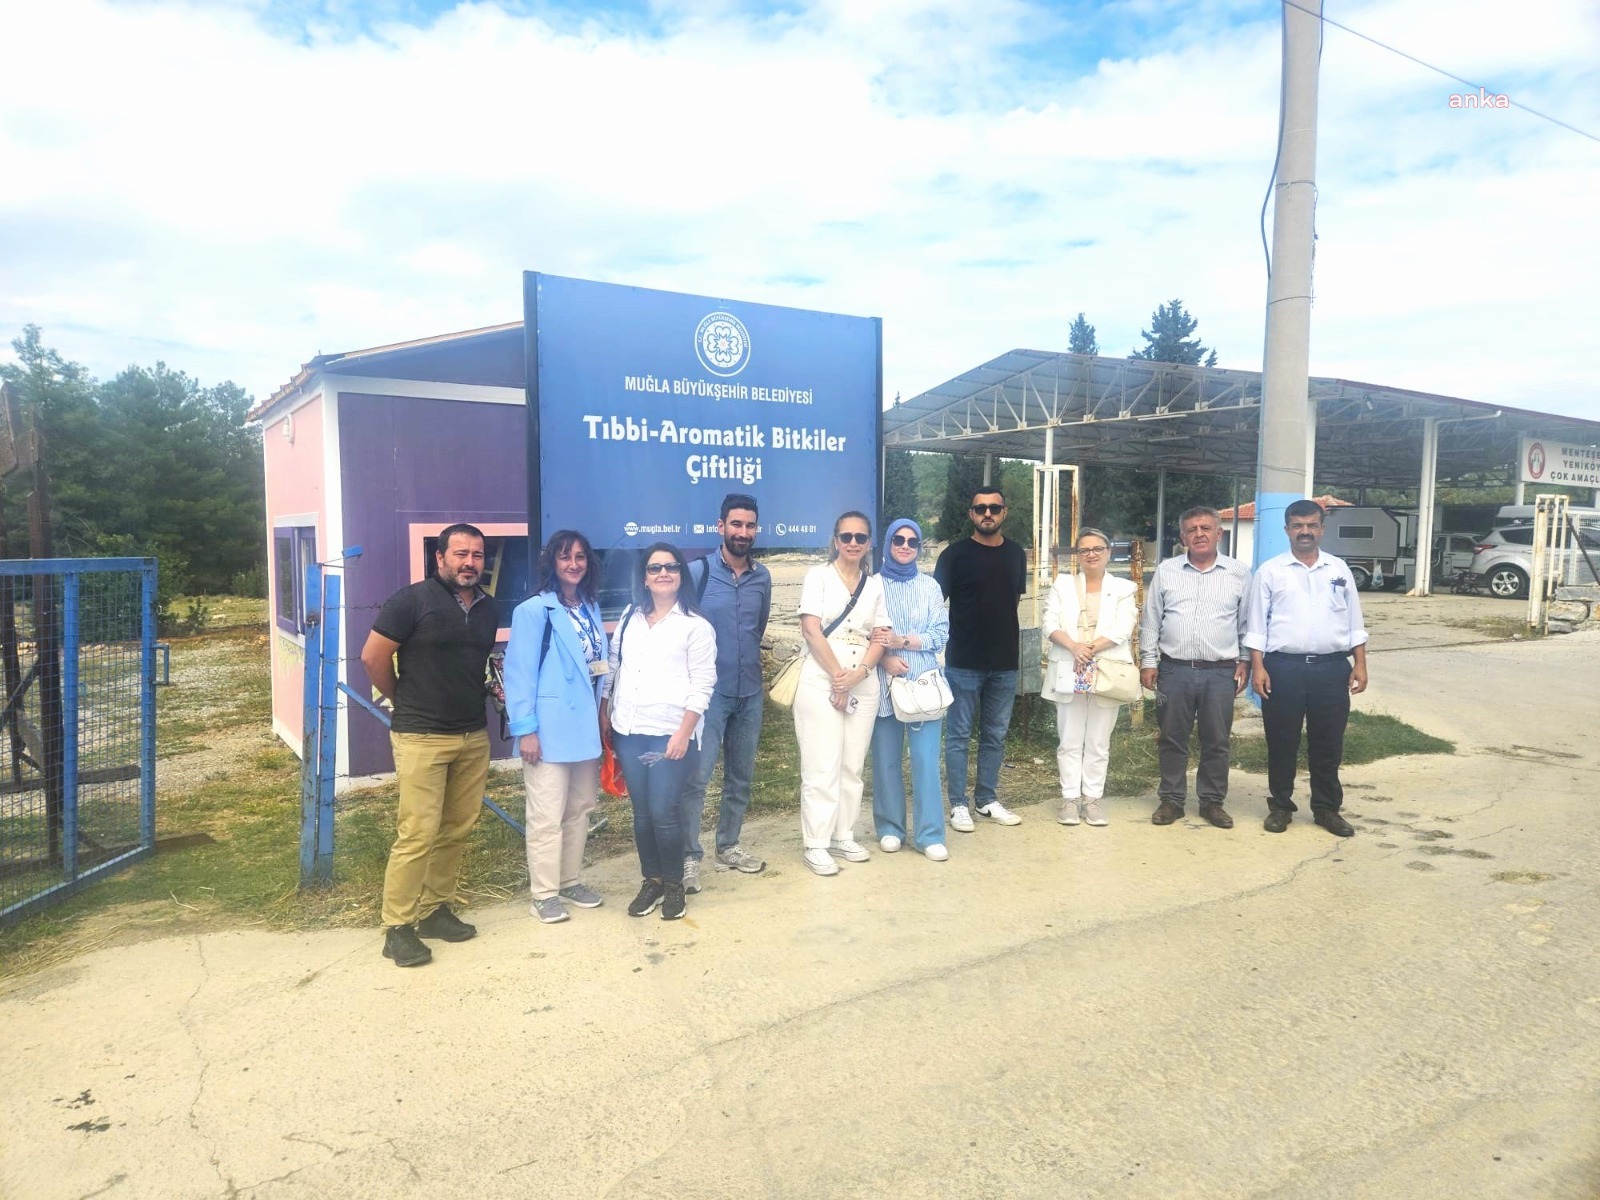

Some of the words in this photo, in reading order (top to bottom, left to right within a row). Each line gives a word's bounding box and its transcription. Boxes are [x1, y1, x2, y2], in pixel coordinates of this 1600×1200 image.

[625, 374, 670, 393] MUĞLA
[673, 378, 748, 401] BÜYÜKŞEHİR
[751, 387, 813, 405] BELEDİYESİ
[583, 415, 765, 448] Tıbbi-Aromatik
[772, 427, 846, 452] Bitkiler
[686, 455, 762, 484] Çiftliği
[1550, 471, 1569, 481] ÇOK
[788, 525, 799, 533] 444
[809, 525, 817, 533] 01
